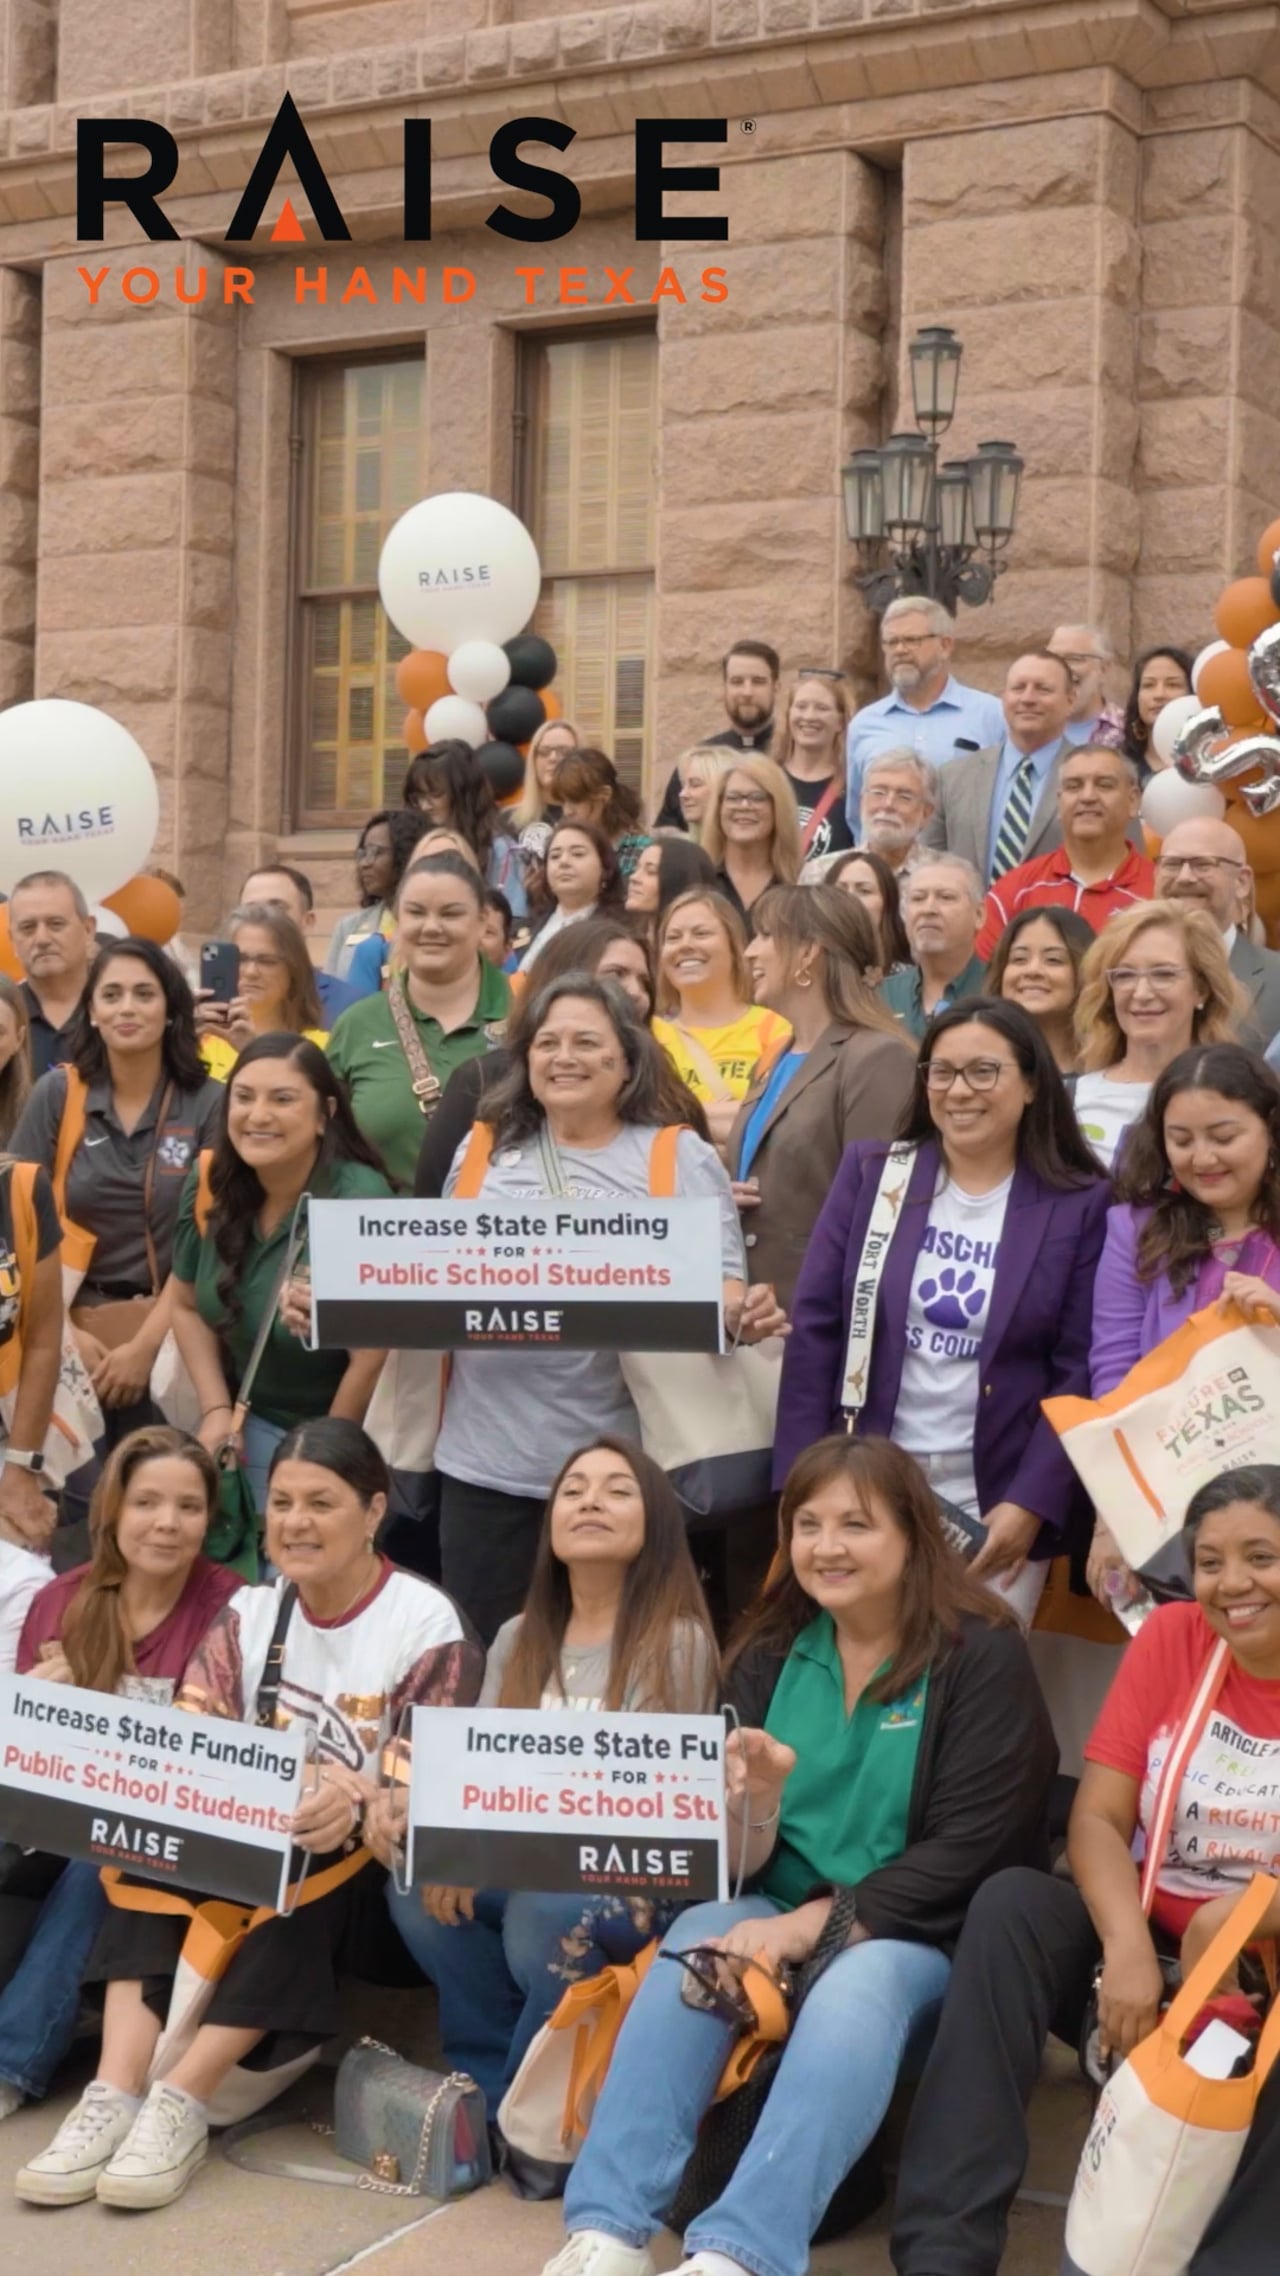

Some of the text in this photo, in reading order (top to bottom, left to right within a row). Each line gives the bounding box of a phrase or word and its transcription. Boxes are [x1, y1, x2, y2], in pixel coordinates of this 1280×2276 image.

[418, 565, 491, 587] RAISE
[17, 806, 114, 837] RAISE
[359, 1213, 668, 1240] Increase $tate Funding
[494, 1247, 525, 1257] FOR
[359, 1263, 671, 1286] Public School Students
[852, 1230, 890, 1340] FORT WORTH
[465, 1307, 561, 1332] RAISE
[1164, 1384, 1265, 1459] TEXAS
[13, 1692, 296, 1782] Increase $tate Funding
[467, 1726, 584, 1756] Increase
[594, 1728, 670, 1760] $tate
[1210, 1721, 1270, 1757] ARTICLE
[128, 1754, 158, 1771] FOR
[612, 1770, 647, 1784] FOR
[4, 1745, 292, 1834] Public School Students
[463, 1784, 549, 1814] Public
[558, 1788, 663, 1819] School
[1186, 1801, 1280, 1833] A RIGHT
[90, 1818, 179, 1862] RAISE
[1186, 1836, 1198, 1853] A
[579, 1842, 690, 1875] RAISE
